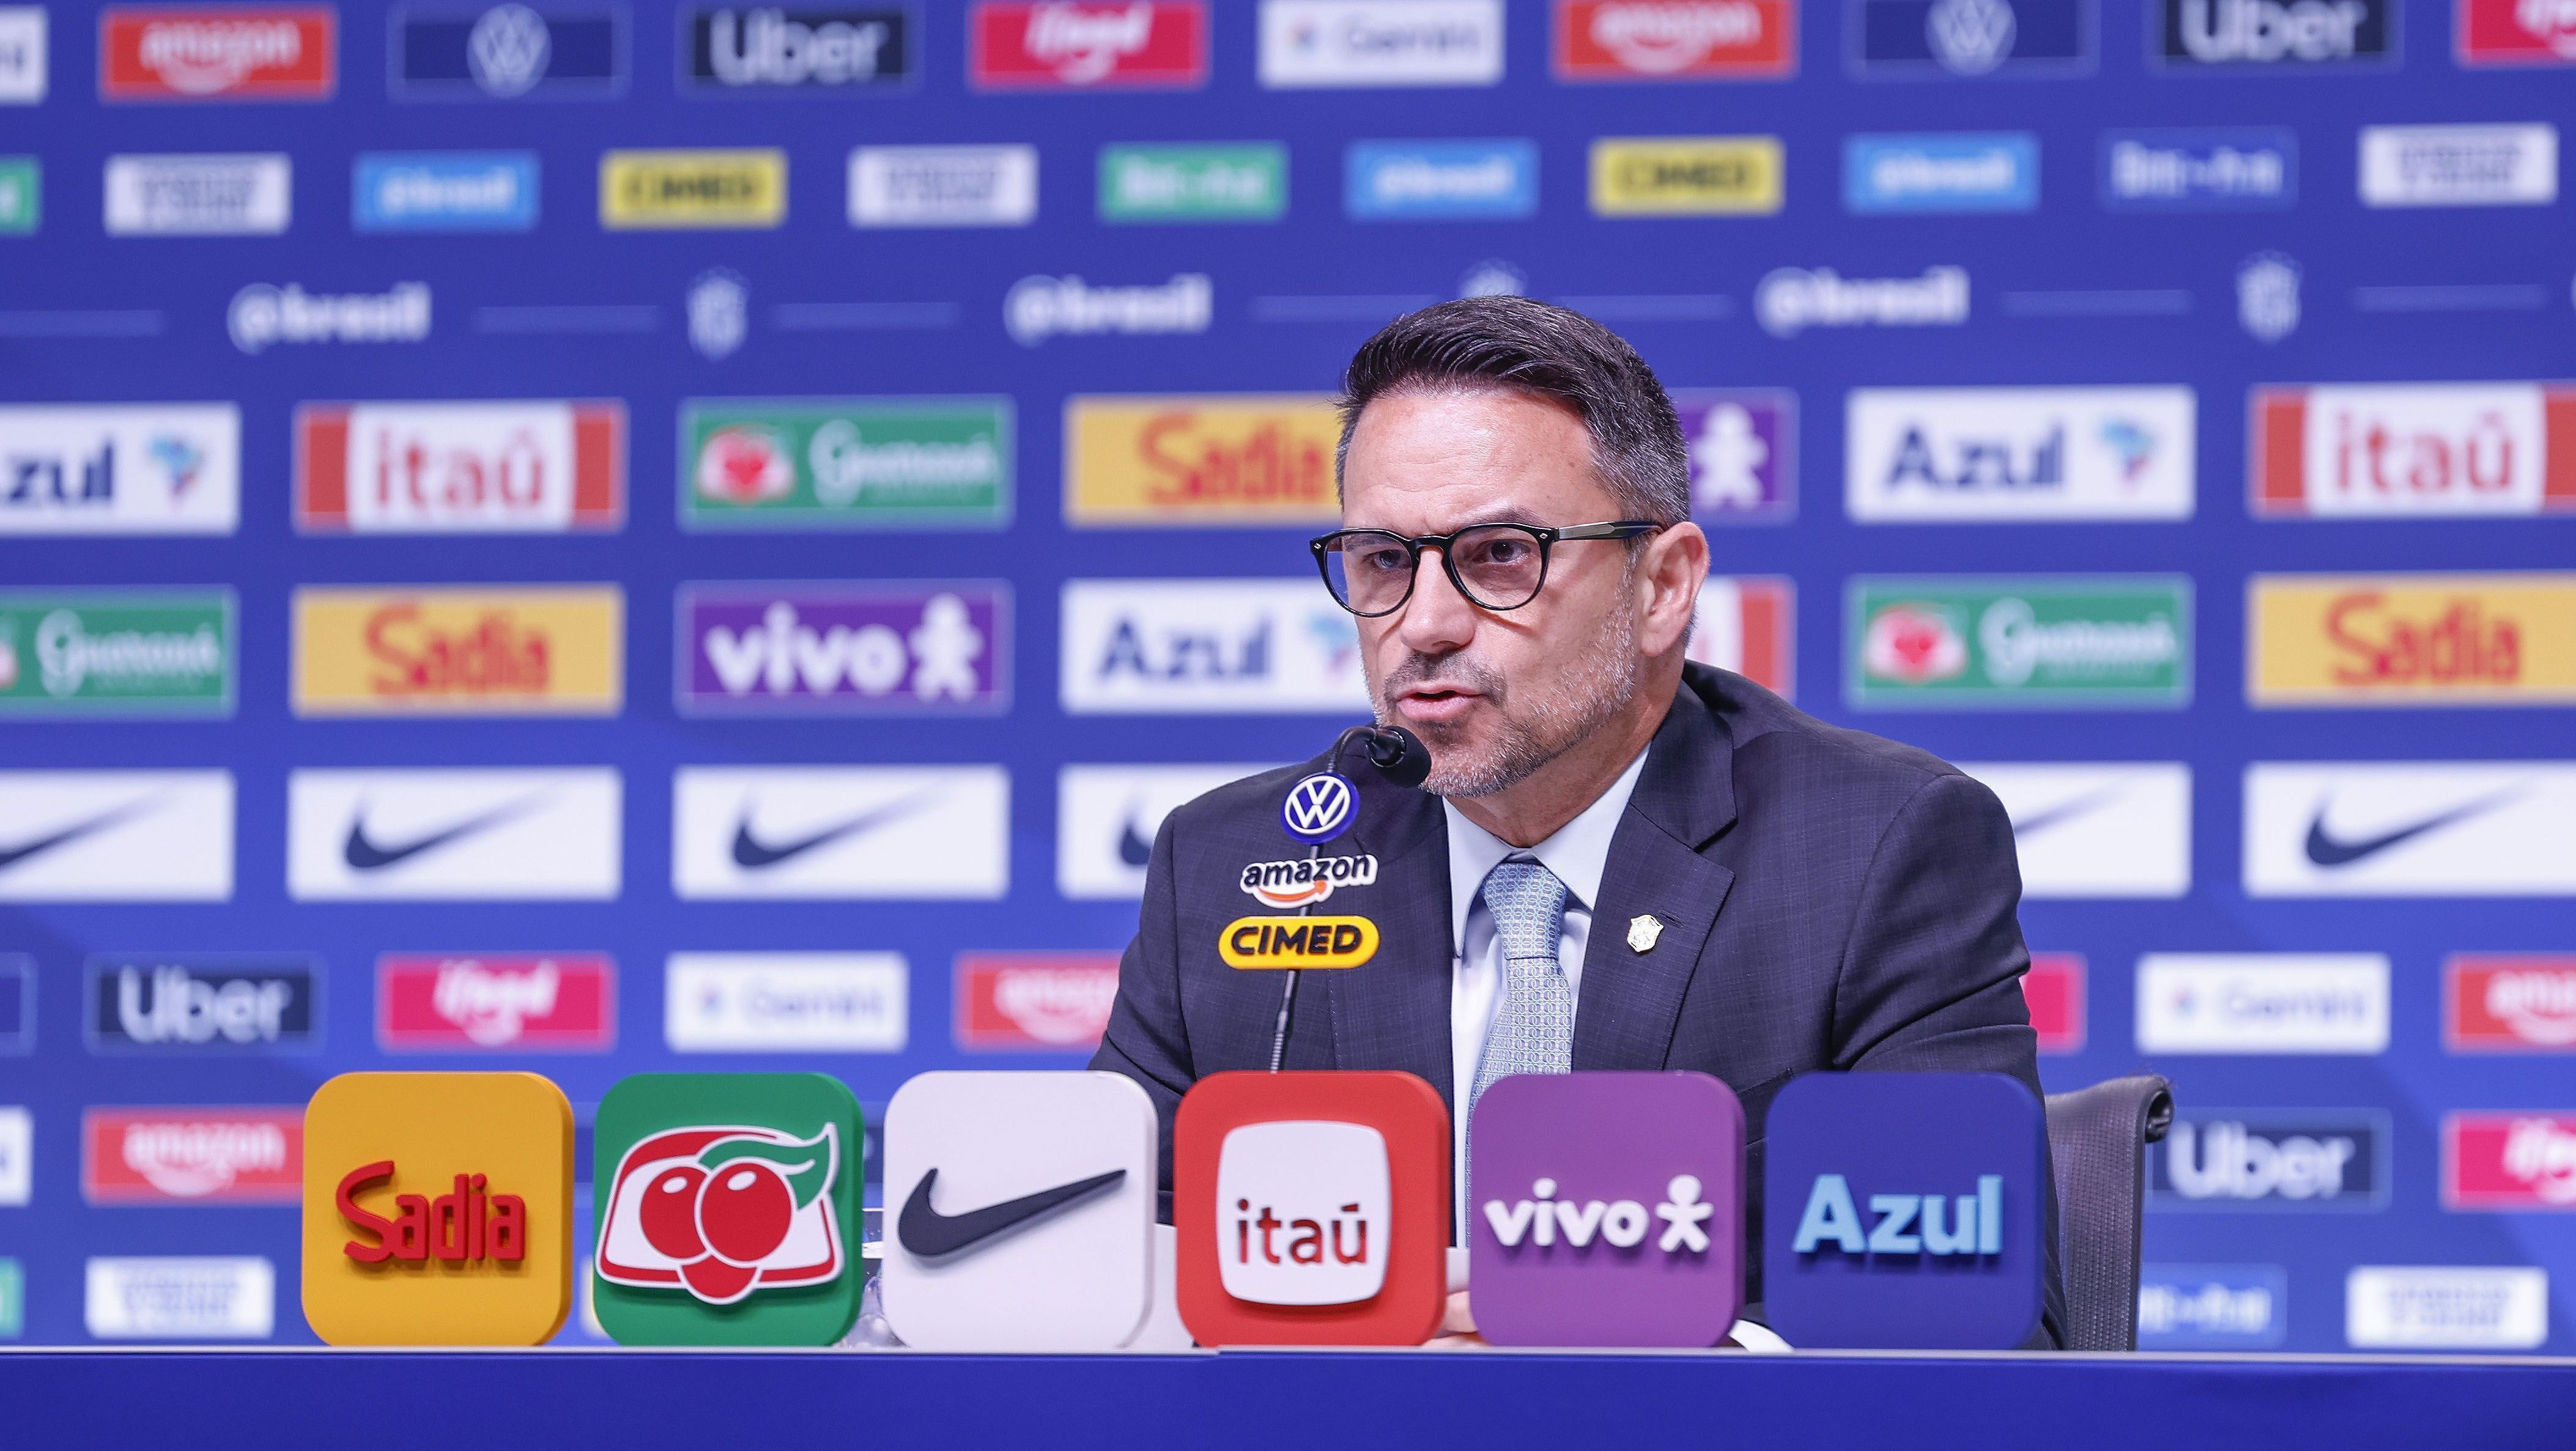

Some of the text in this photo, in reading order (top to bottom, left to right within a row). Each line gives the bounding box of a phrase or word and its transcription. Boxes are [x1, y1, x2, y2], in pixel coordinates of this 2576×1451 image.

[709, 8, 889, 85] Uber
[2179, 0, 2367, 62] Uber
[0, 434, 116, 503] zul
[1138, 412, 1333, 506] Sadia
[1881, 417, 2067, 489] Azul
[361, 599, 552, 699] Sadia
[705, 602, 906, 698] vivo
[1098, 616, 1273, 683] Azul
[2325, 590, 2522, 687] Sadia
[1243, 855, 1371, 888] amazon
[1232, 925, 1363, 955] CIMED
[119, 965, 292, 1044] Uber
[2166, 1121, 2356, 1200] Uber
[336, 1161, 526, 1263] Sadia
[1237, 1199, 1368, 1265] itaú
[1484, 1178, 1651, 1247] vivo
[1792, 1174, 2004, 1255] Azul
